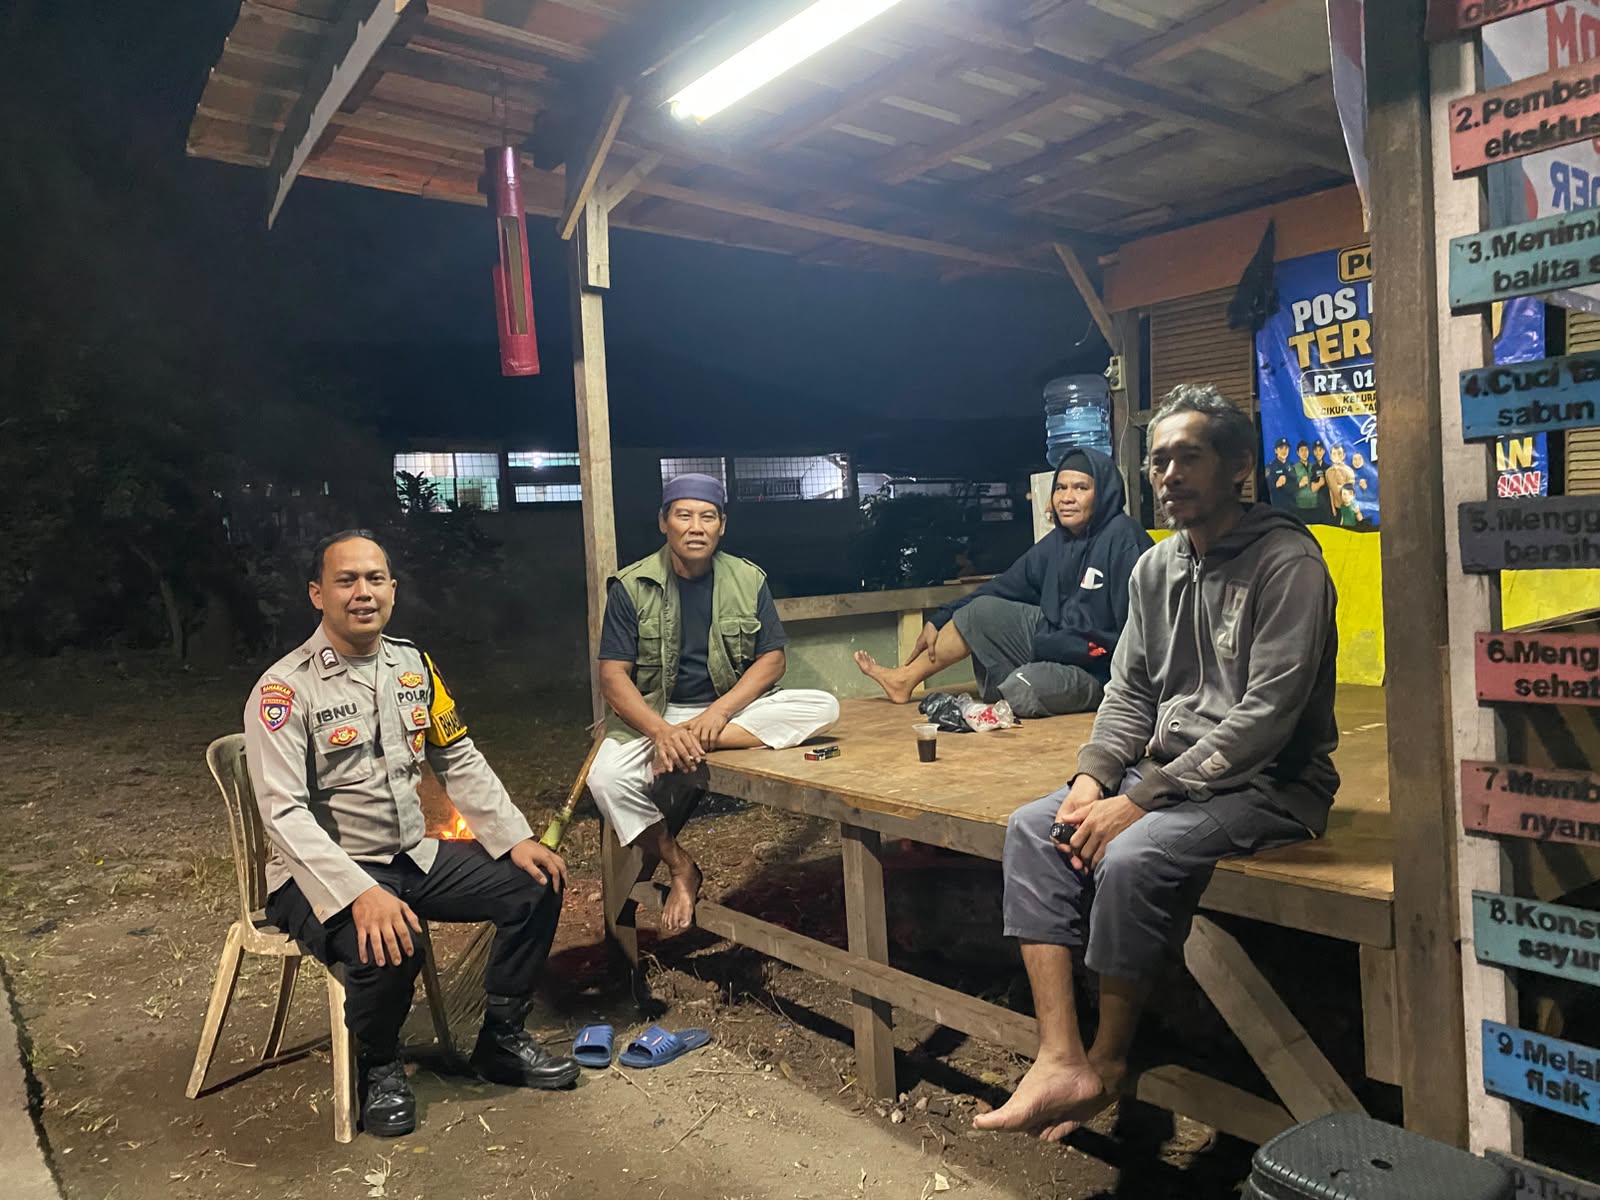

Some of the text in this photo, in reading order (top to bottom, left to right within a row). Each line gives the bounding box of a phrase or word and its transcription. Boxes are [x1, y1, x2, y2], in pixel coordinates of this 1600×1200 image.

[1468, 212, 1600, 264] 3.Menim
[1493, 257, 1580, 292] balita
[1291, 287, 1357, 333] POS
[1289, 319, 1372, 368] TER
[1353, 369, 1376, 389] 01
[1497, 399, 1595, 427] sabun
[316, 702, 358, 724] IBNU
[1490, 898, 1600, 941] 8.Kons
[1498, 1031, 1600, 1083] 9.Mela
[1525, 1068, 1592, 1112] fisik
